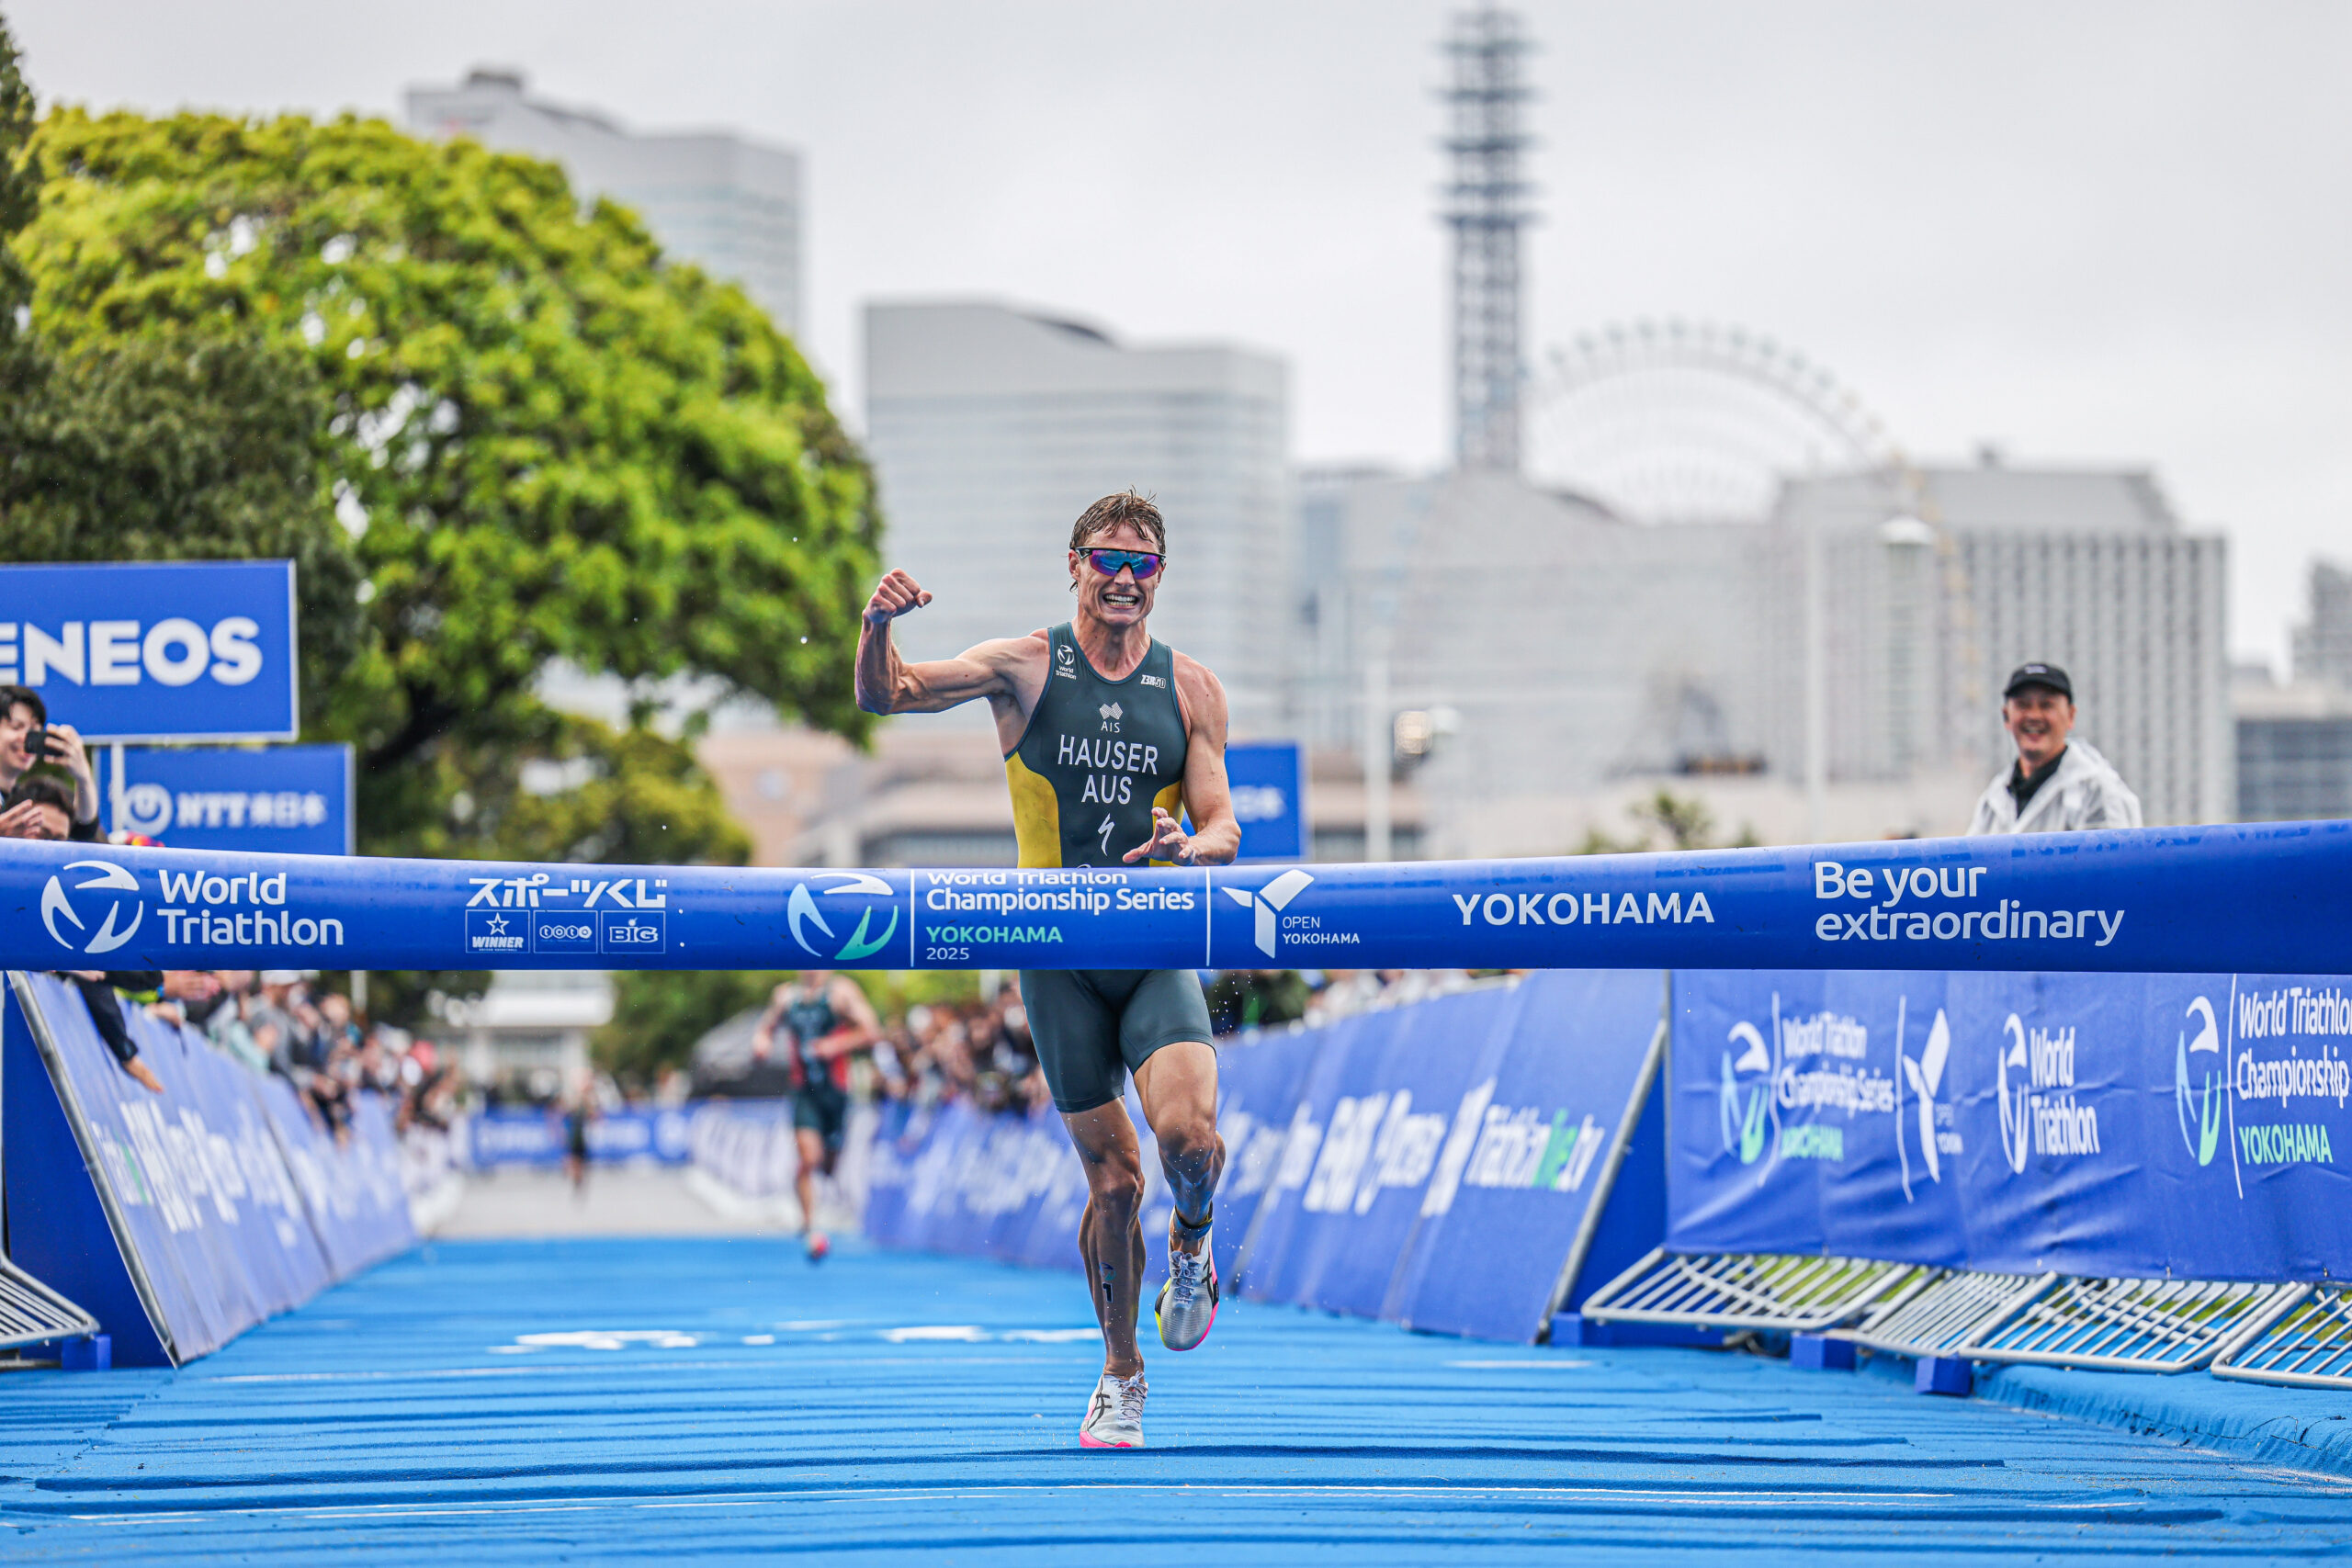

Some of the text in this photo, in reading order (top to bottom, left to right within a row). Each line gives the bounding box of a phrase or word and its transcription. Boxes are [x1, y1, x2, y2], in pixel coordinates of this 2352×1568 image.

[1101, 721, 1121, 733] AIS
[1057, 735, 1159, 775] HAUSER
[1081, 774, 1132, 805] AUS
[158, 869, 287, 905] World
[466, 873, 668, 908] スポーツくじ
[927, 872, 1127, 885] World Triathlon
[1815, 861, 1987, 908] Be your
[926, 886, 1195, 915] Championship Series
[1453, 891, 1715, 926] YOKOHAMA
[156, 908, 344, 946] Triathlon
[539, 925, 593, 939] toto
[926, 926, 1064, 943] YOKOHAMA
[1282, 932, 1361, 944] YOKOHAMA
[1283, 916, 1321, 930] OPEN
[1815, 898, 2125, 947] extraordinary
[472, 936, 524, 948] WINNER
[926, 947, 970, 960] 2025
[2239, 986, 2352, 1039] World Triathlo
[2030, 1026, 2075, 1088] World
[2236, 1043, 2351, 1110] Championship
[2030, 1094, 2101, 1156] Triathlon
[2238, 1123, 2335, 1165] YOKOHAMA
[1102, 1281, 1114, 1303] 1
